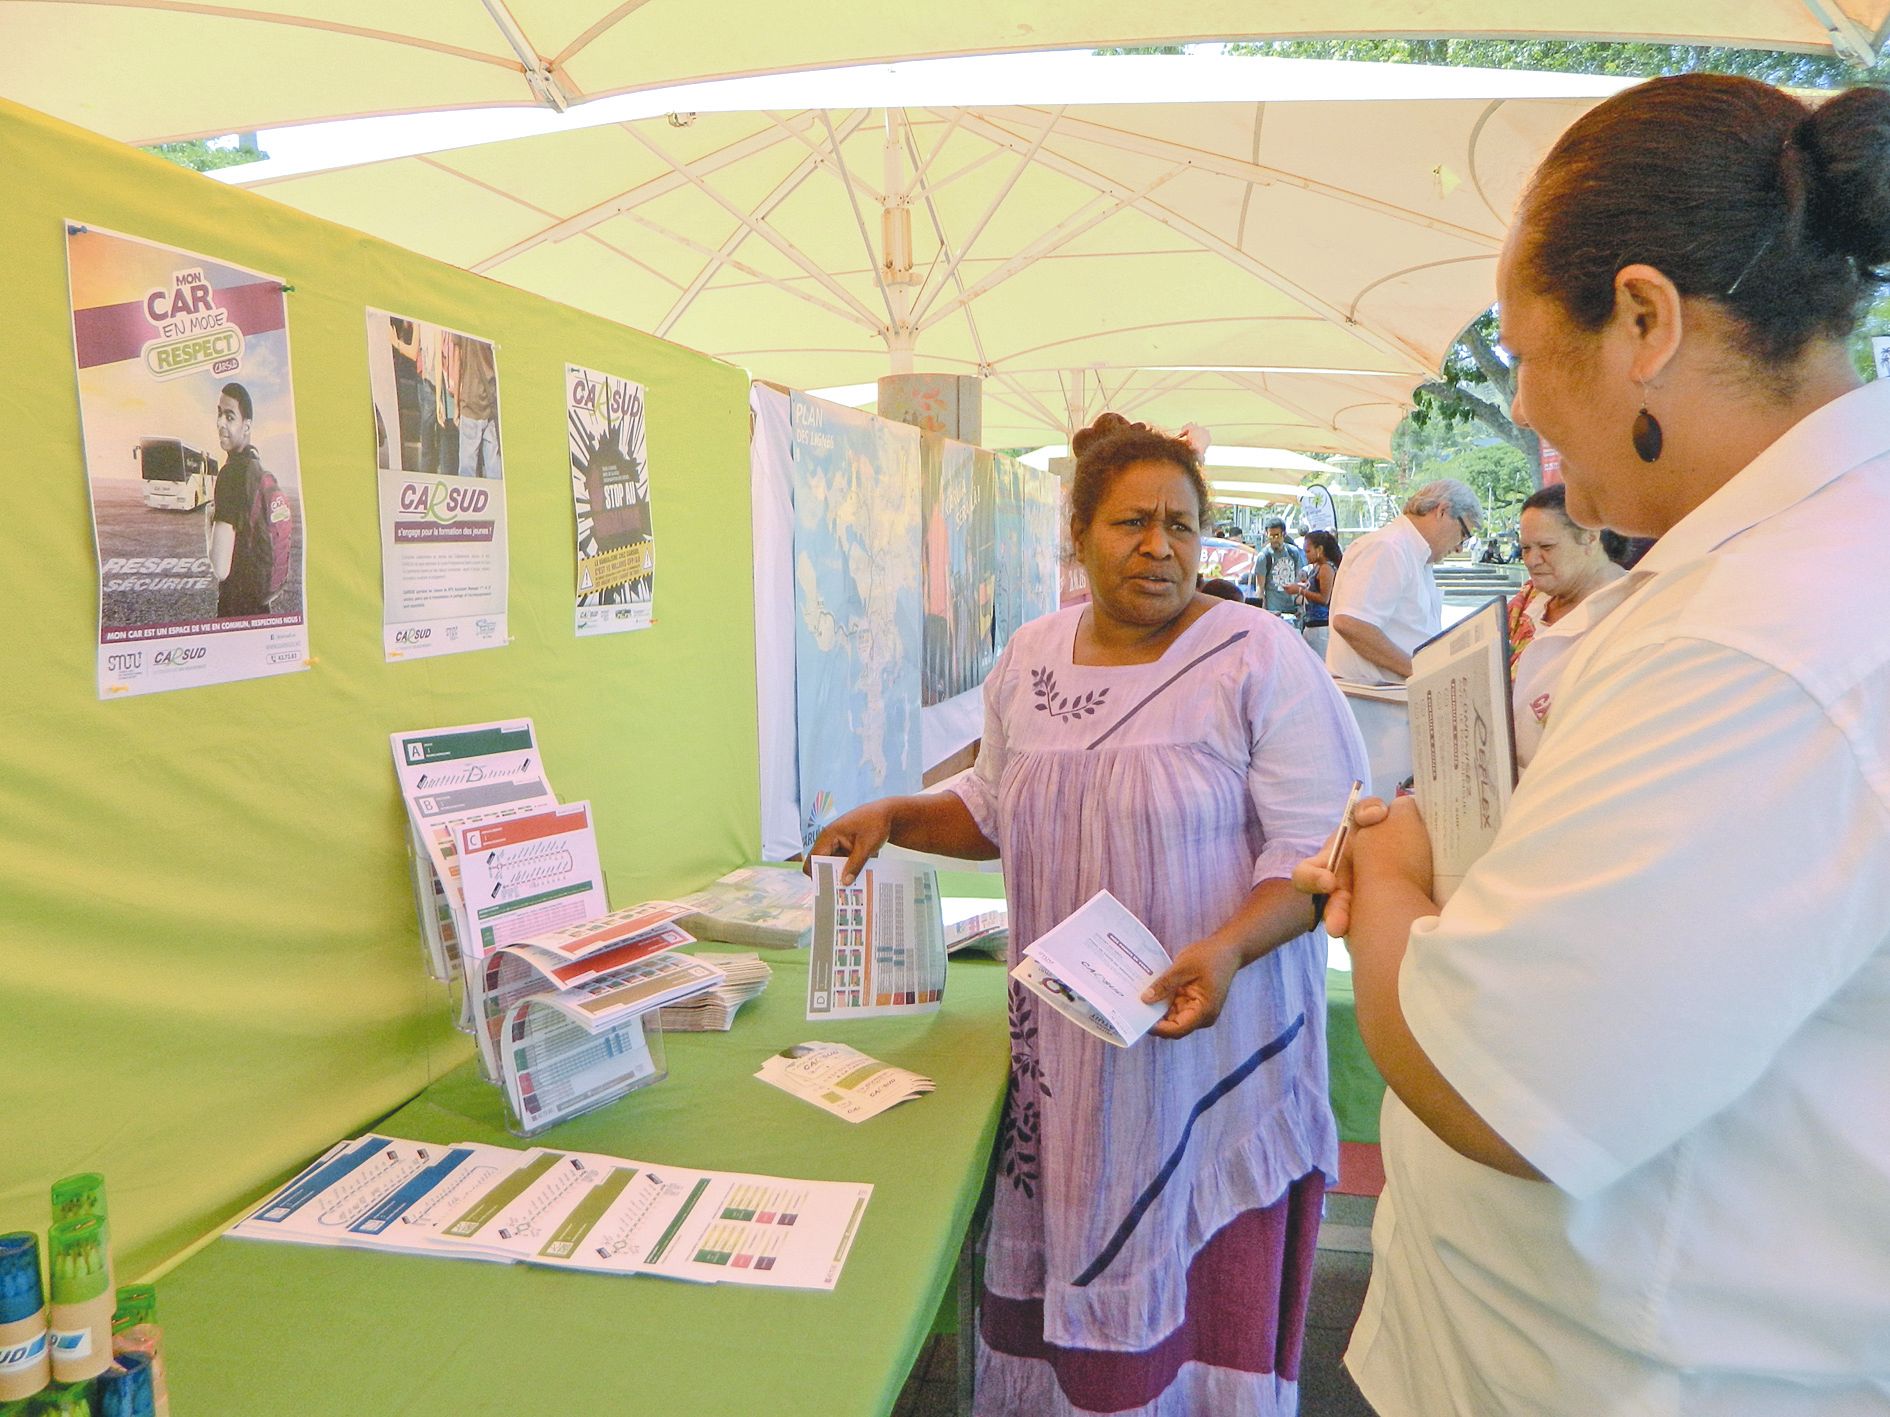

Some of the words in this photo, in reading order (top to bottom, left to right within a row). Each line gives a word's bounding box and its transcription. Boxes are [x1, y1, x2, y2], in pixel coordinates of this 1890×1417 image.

[176, 272, 201, 287] MON
[147, 284, 213, 321] CAR
[163, 323, 186, 338] EN
[191, 312, 224, 333] MODE
[157, 333, 234, 370] RESPECT
[796, 403, 823, 428] PLAN
[400, 480, 489, 523] CARSUD
[604, 483, 623, 509] STOP
[422, 528, 433, 538] pour
[434, 527, 439, 536] la
[439, 527, 462, 536] formation
[463, 527, 472, 536] des
[102, 557, 214, 573] RESPEC
[107, 632, 127, 640] MON
[128, 630, 142, 639] CAR
[144, 628, 155, 637] EST
[157, 627, 167, 635] UN
[169, 625, 190, 634] ESPACE
[191, 624, 199, 632] DE
[201, 623, 210, 631] VIE
[212, 622, 220, 630] EN
[396, 627, 432, 643] CARSUD
[154, 647, 207, 666] CARSUD
[412, 745, 421, 758] A
[423, 799, 433, 811] B
[469, 834, 477, 846] C
